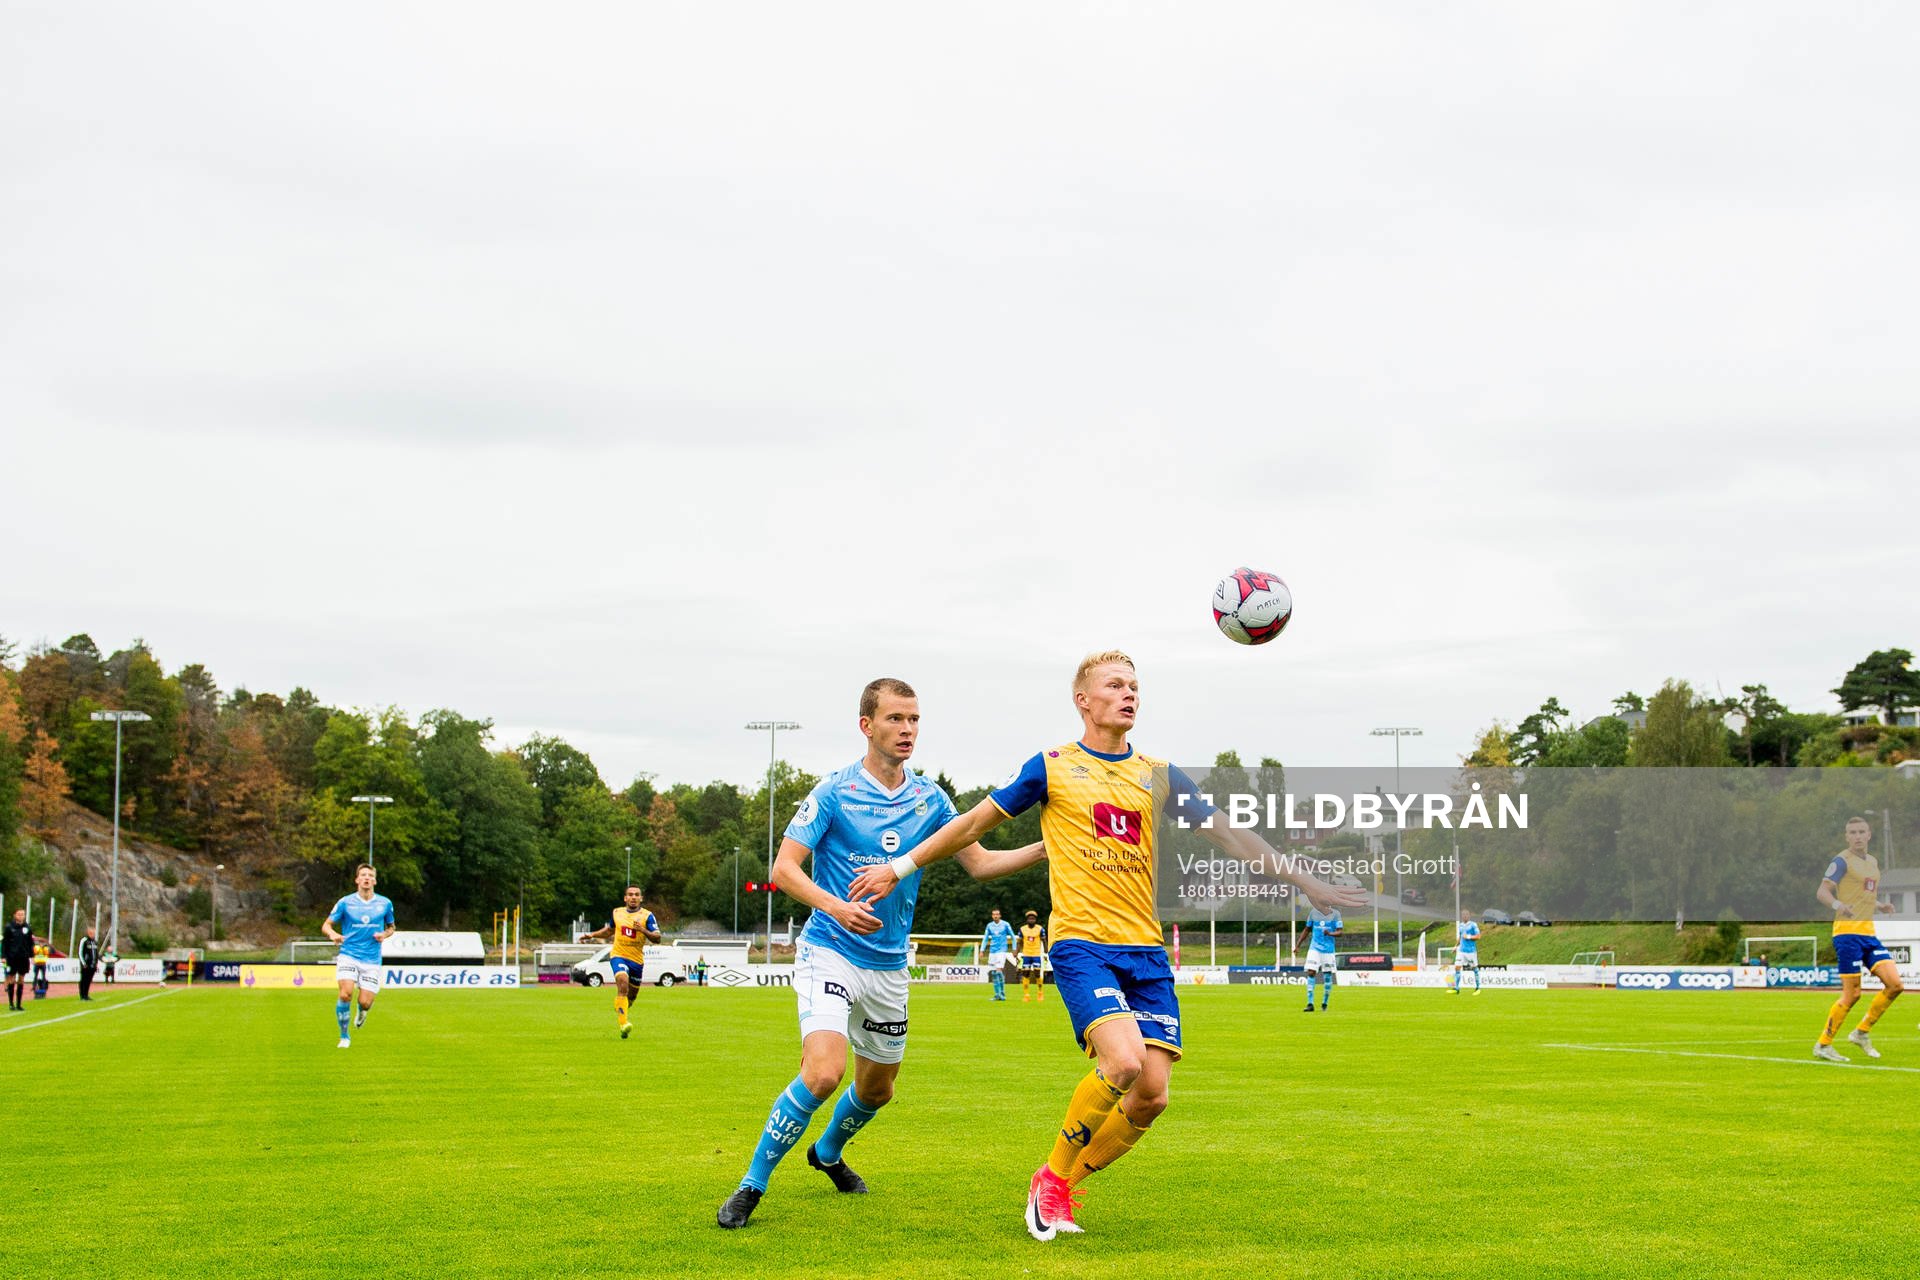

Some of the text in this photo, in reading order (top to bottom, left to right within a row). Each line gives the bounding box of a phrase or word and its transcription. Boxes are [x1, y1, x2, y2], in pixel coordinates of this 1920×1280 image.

[1256, 597, 1281, 611] MATCH
[848, 852, 885, 864] Sandnes
[1080, 849, 1103, 858] The
[385, 970, 480, 985] Norsafe
[489, 973, 517, 985] as
[945, 966, 980, 976] ODDEN
[1779, 968, 1829, 985] People
[1462, 976, 1546, 986] Leekassen.no
[1618, 973, 1671, 989] coop
[1678, 973, 1732, 989] coop
[766, 1120, 796, 1145] Safe
